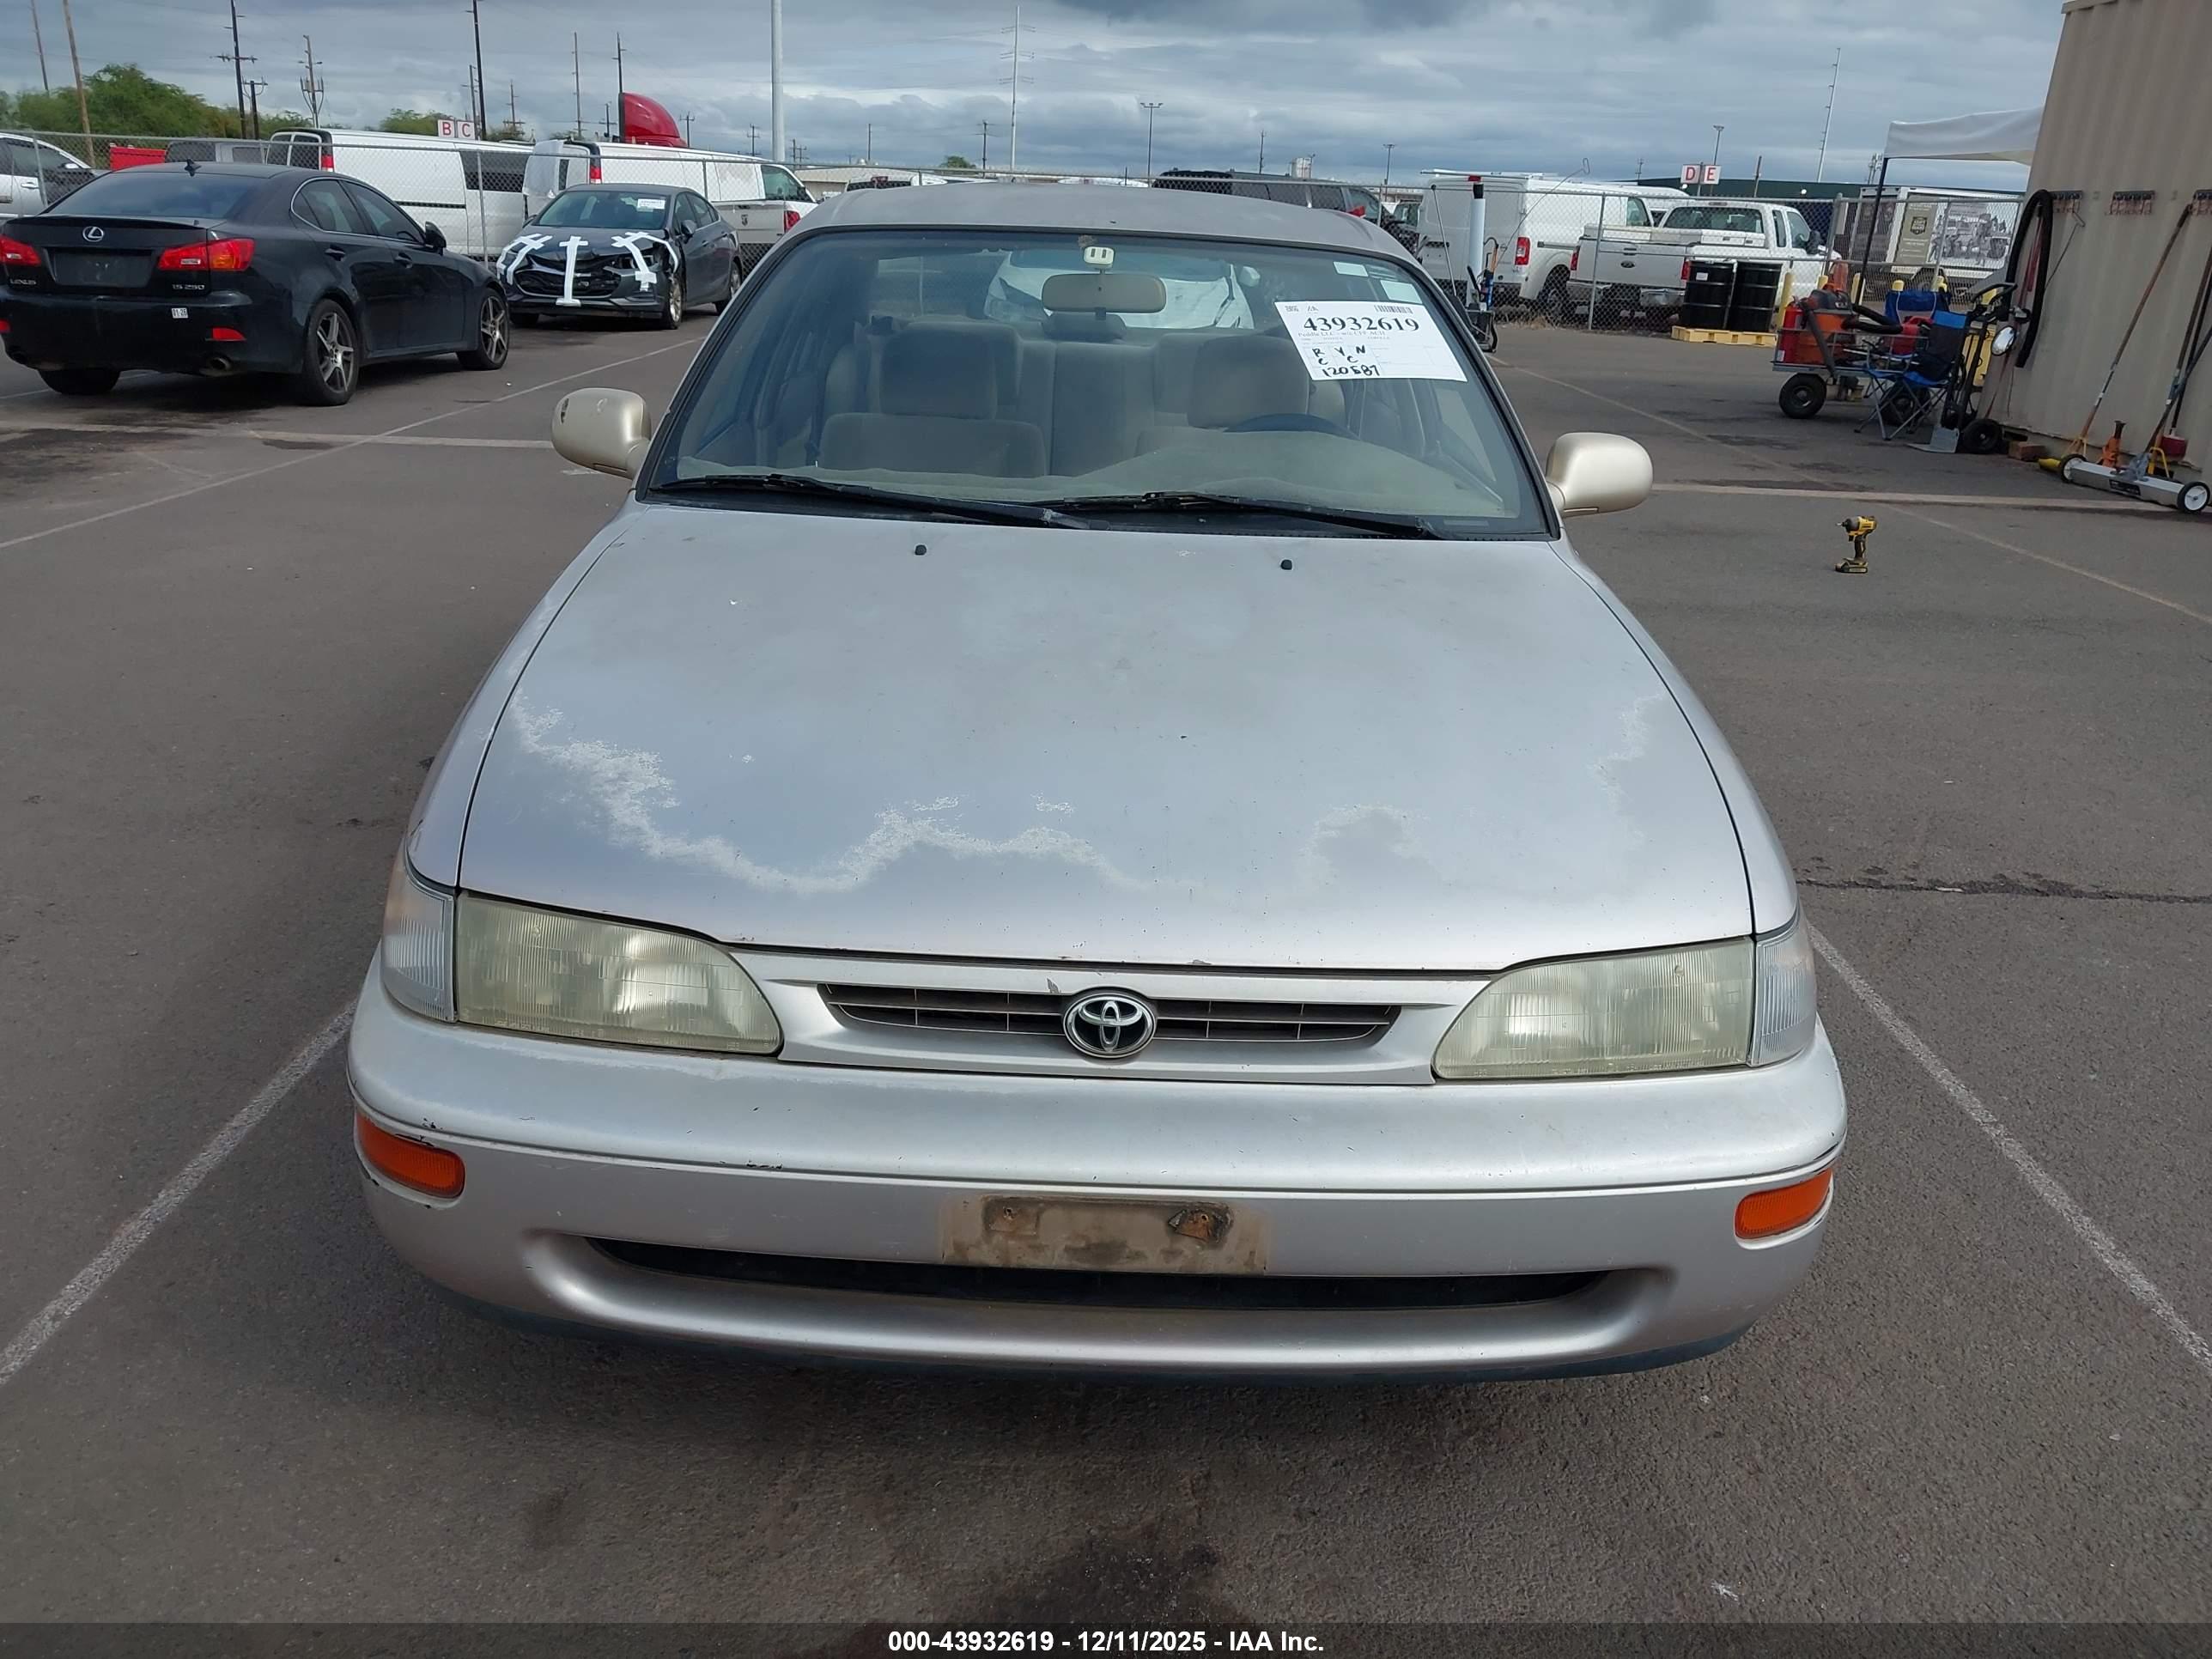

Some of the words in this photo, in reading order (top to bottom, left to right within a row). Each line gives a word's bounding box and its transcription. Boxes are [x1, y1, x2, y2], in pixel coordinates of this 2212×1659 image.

[442, 122, 452, 136] B
[462, 123, 471, 137] C
[1686, 167, 1696, 181] D
[1707, 167, 1716, 181] E
[1304, 317, 1419, 331] 43932619
